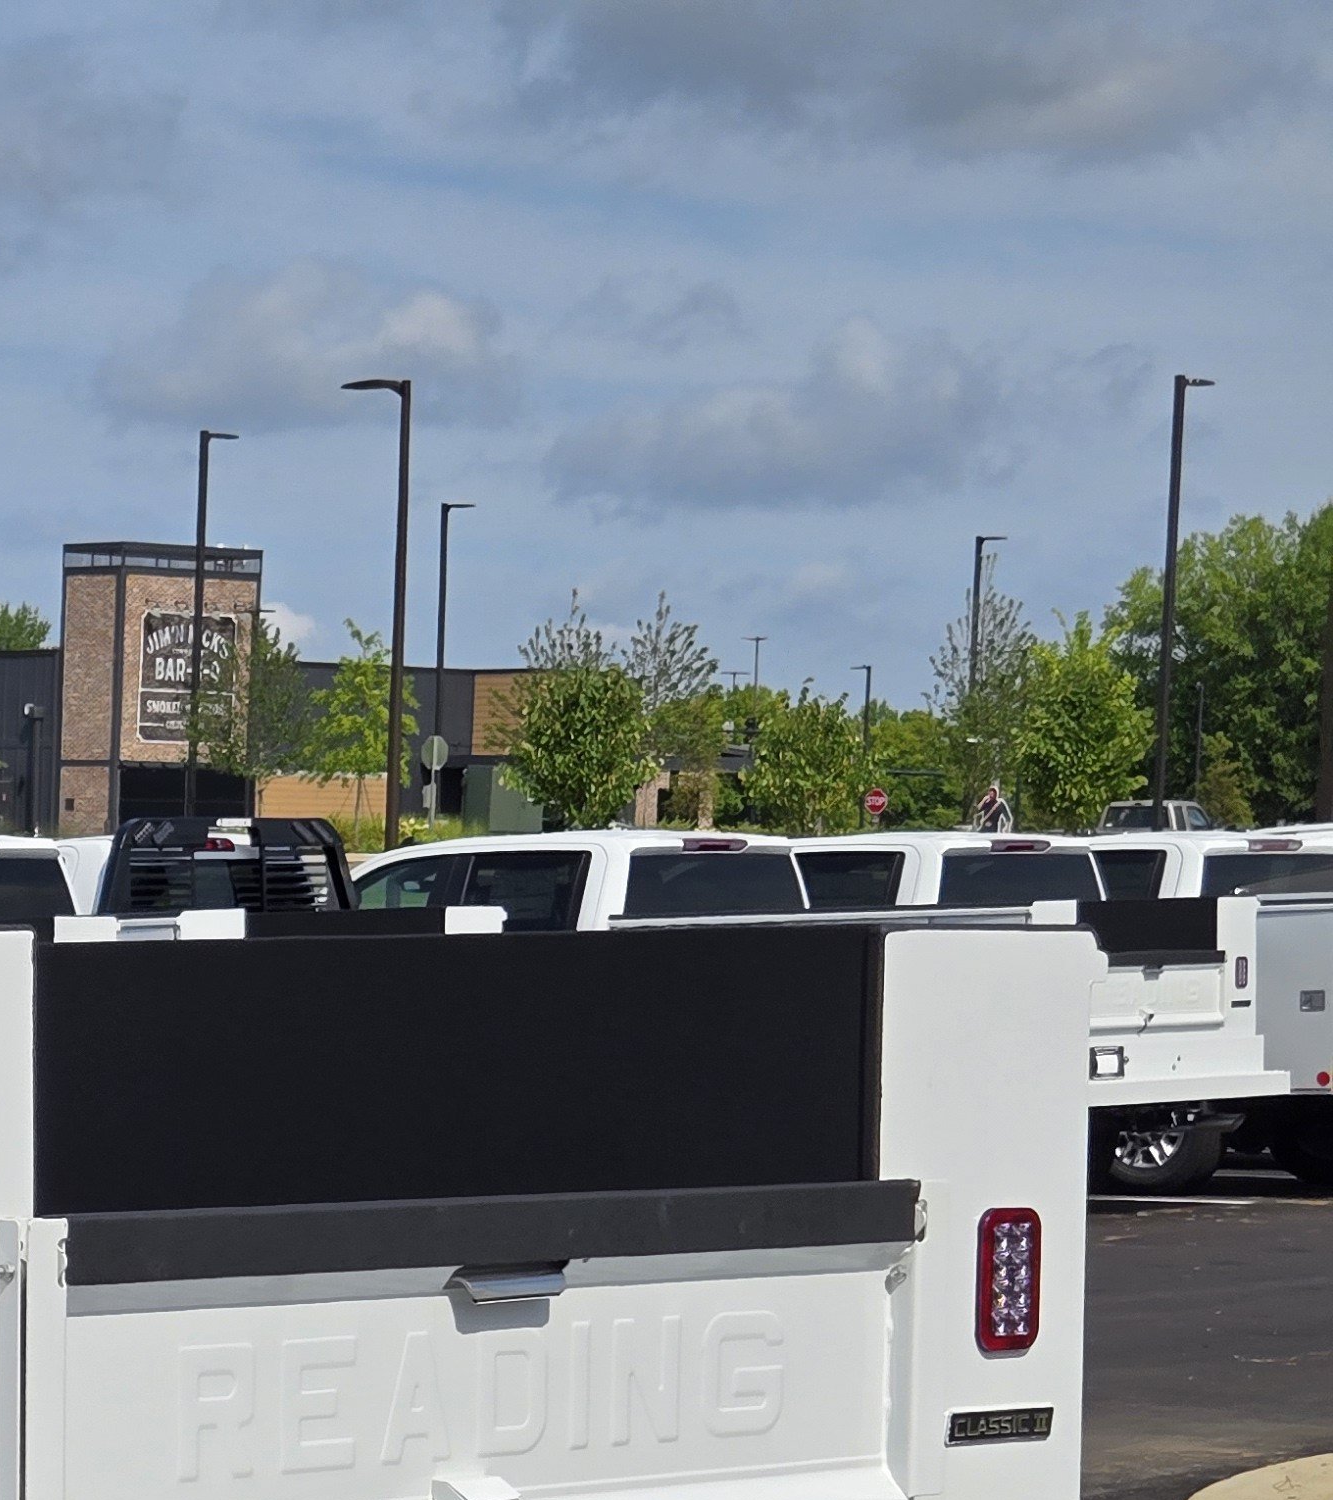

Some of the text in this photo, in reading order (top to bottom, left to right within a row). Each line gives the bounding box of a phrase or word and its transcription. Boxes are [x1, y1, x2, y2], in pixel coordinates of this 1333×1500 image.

[155, 657, 221, 684] BAR--Q
[866, 796, 886, 806] STOP
[176, 1310, 786, 1484] READING
[953, 1412, 1049, 1438] CLASSIC II
